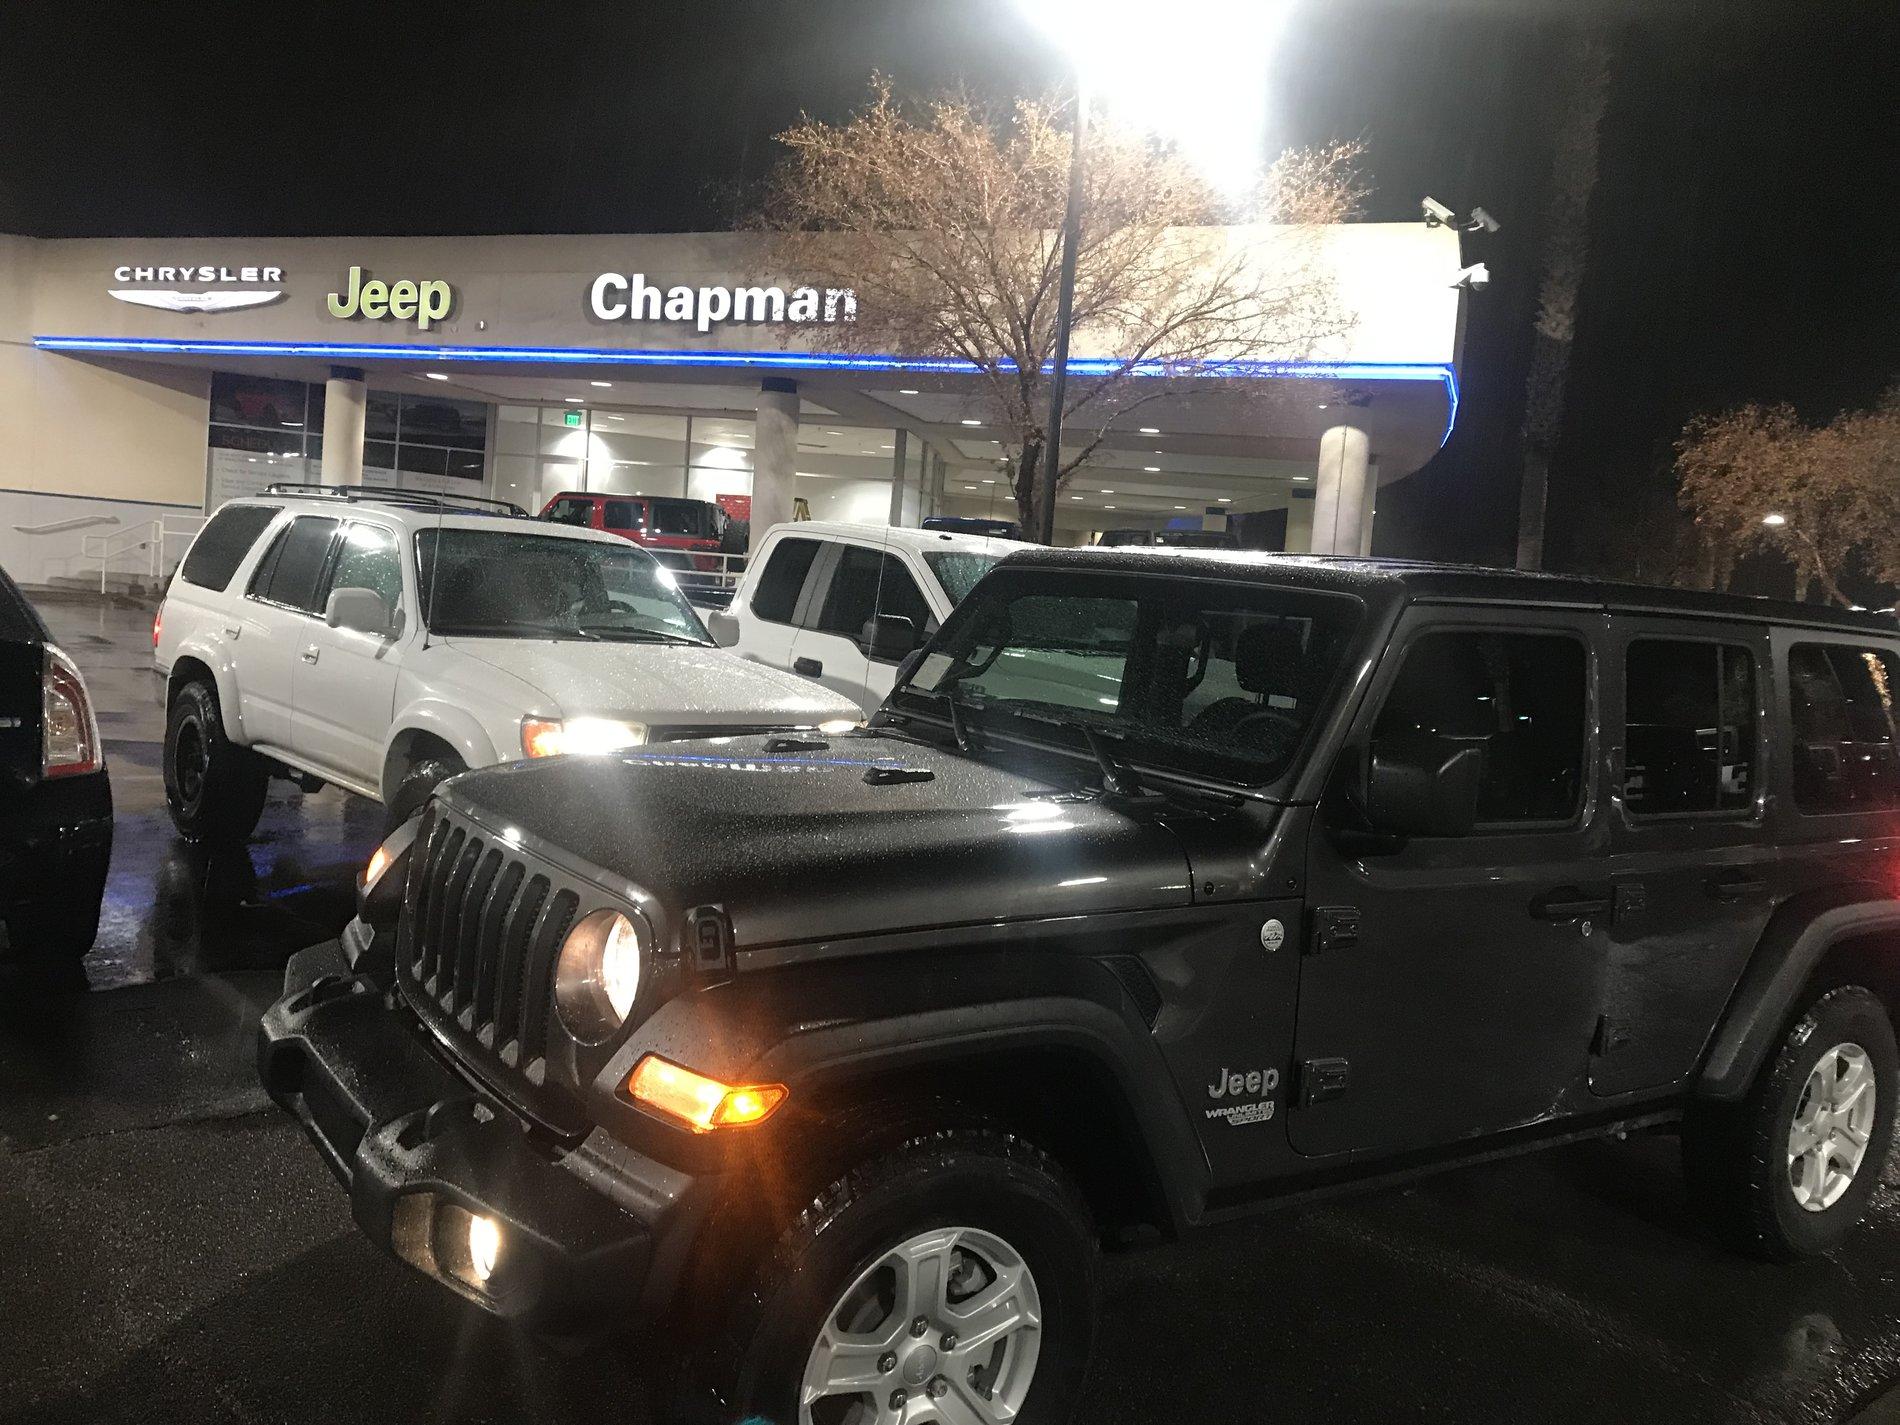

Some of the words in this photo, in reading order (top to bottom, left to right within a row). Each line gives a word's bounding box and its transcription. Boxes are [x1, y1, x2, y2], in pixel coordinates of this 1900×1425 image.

[114, 266, 281, 282] CHRYSLER
[327, 266, 451, 329] Jeep
[591, 272, 857, 331] Chapman
[1208, 1067, 1280, 1099] Jeep
[1205, 1101, 1274, 1119] WRANGLER
